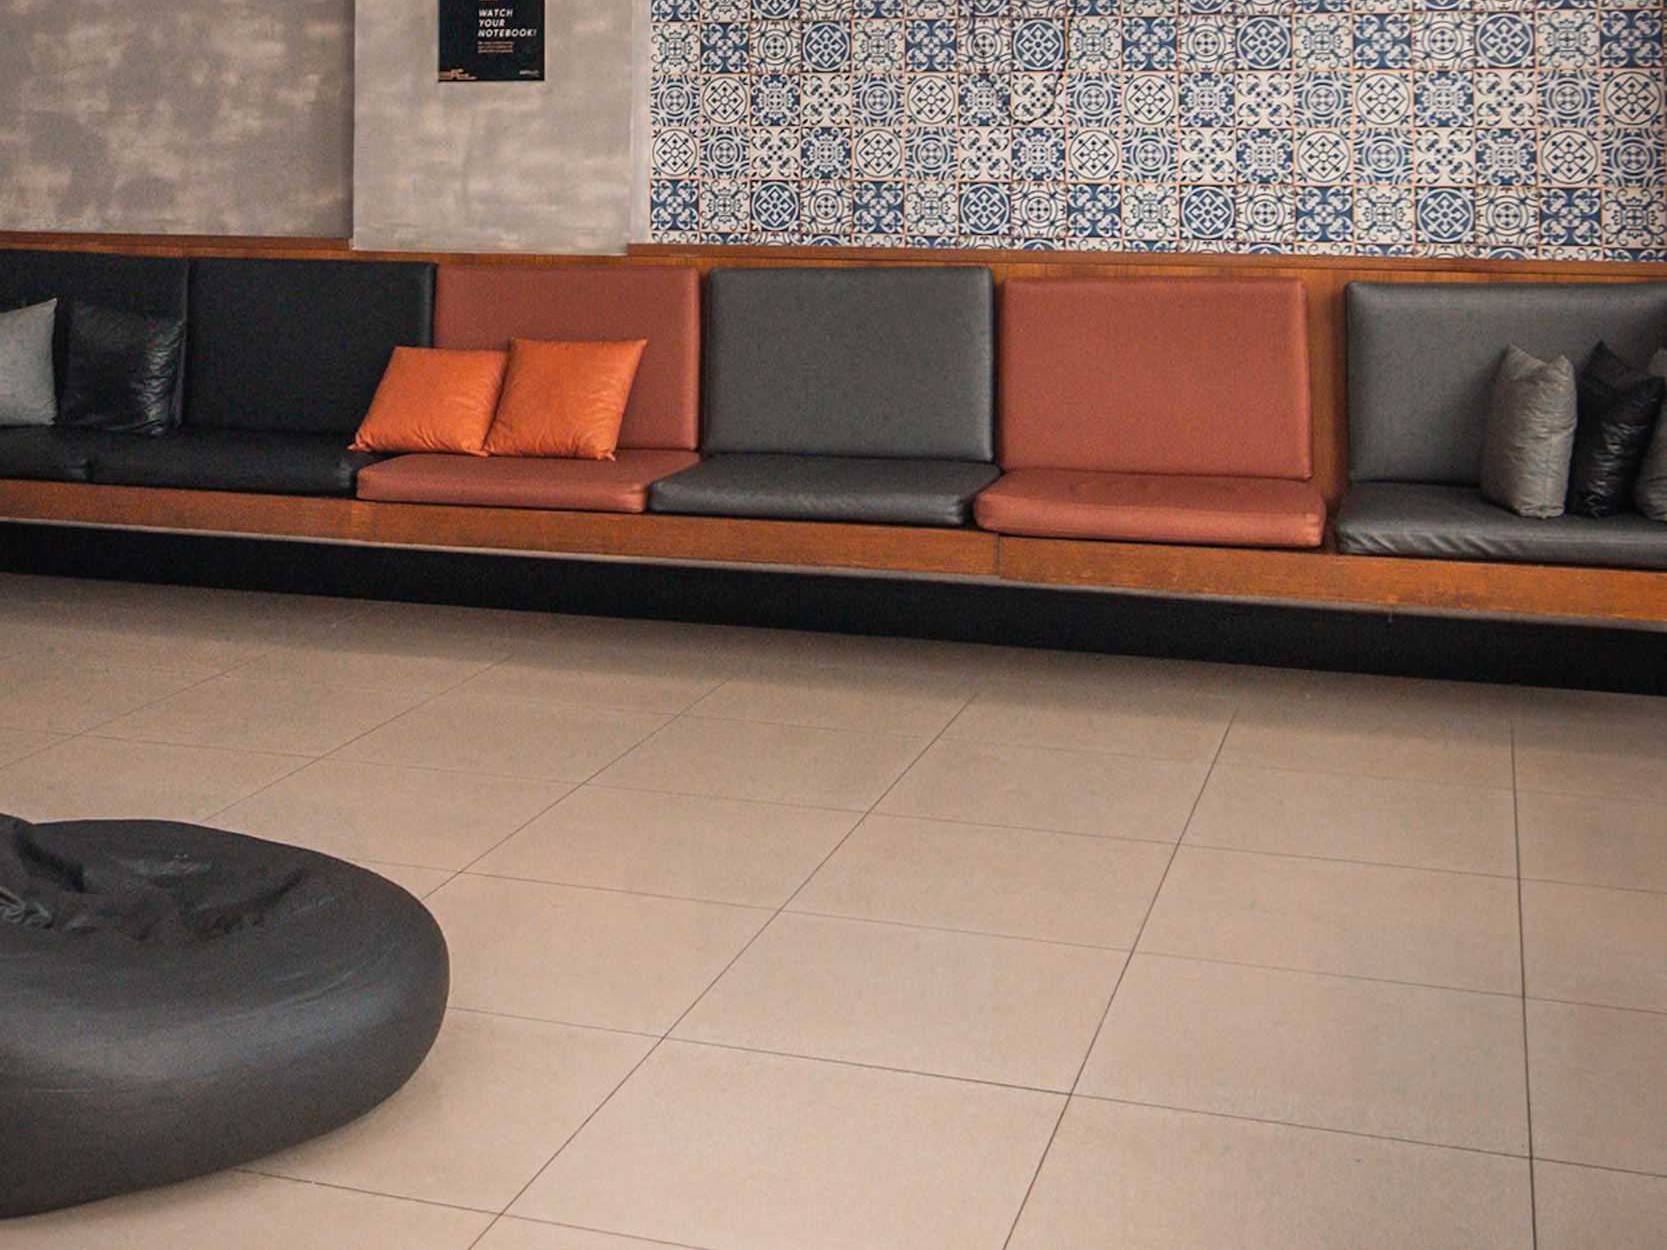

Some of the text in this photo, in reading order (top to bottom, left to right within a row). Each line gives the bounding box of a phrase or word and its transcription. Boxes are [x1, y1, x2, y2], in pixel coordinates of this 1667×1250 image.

[478, 9, 513, 18] WATCH
[479, 19, 506, 28] YOUR
[477, 29, 537, 38] NOTEBOOK!
